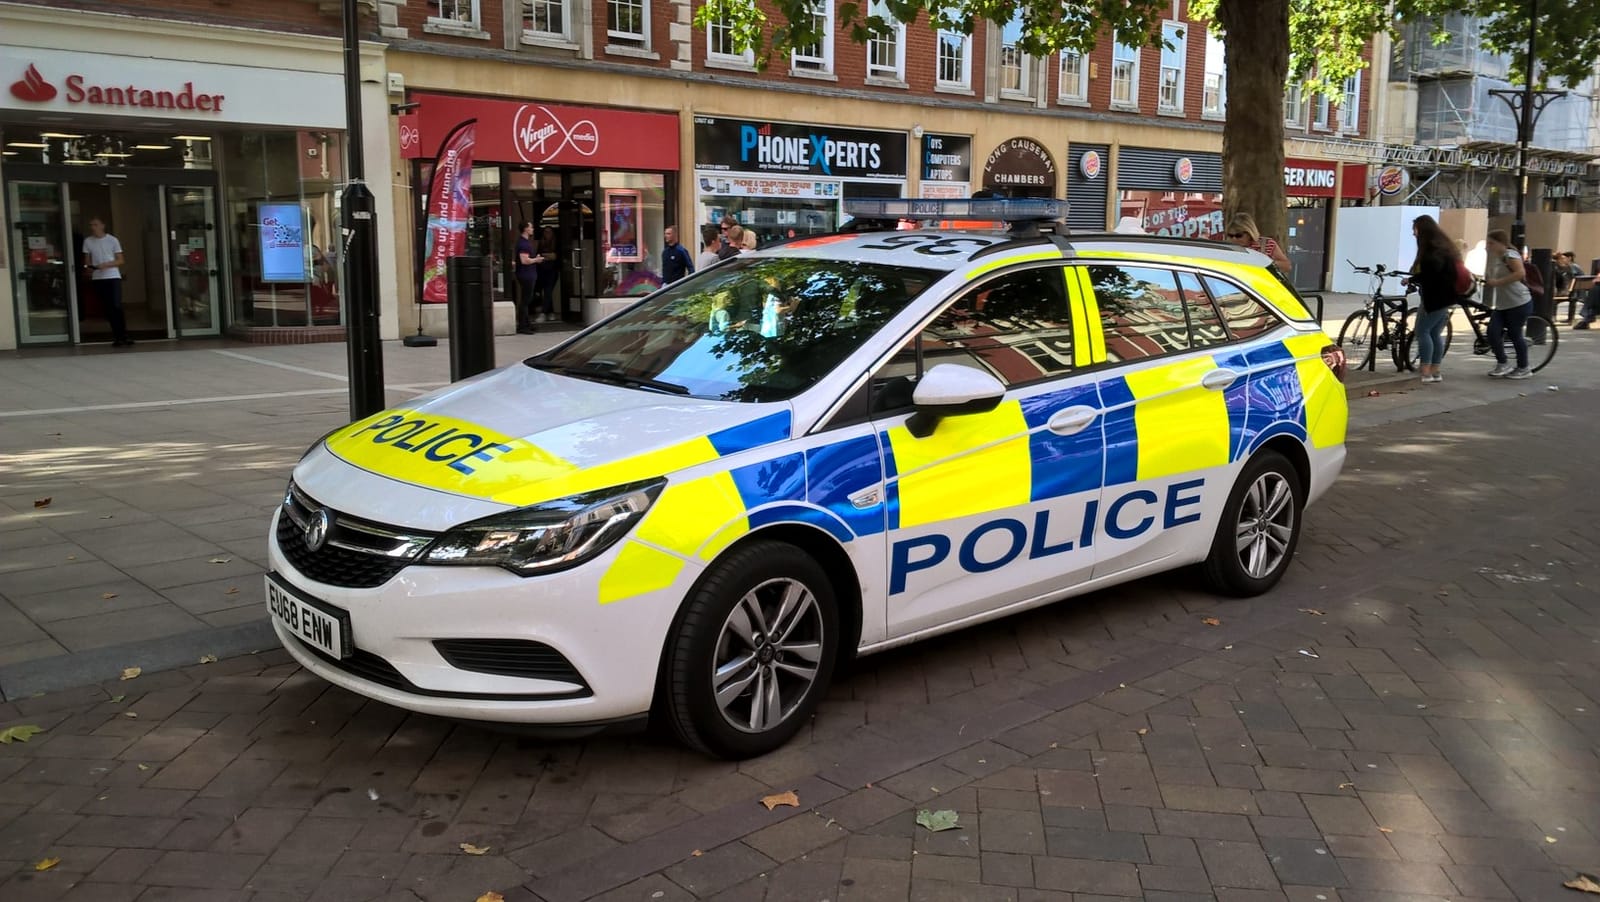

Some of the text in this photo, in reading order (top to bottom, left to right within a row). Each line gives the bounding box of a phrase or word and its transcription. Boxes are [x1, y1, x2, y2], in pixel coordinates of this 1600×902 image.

[65, 74, 225, 112] Santander
[520, 114, 558, 154] Virgin
[573, 133, 595, 142] media
[926, 136, 942, 150] TOYS
[741, 124, 881, 176] PHONEXPERTS
[926, 152, 962, 166] COMPUTERS
[984, 140, 1054, 174] LONG CAUSEWAY
[760, 180, 789, 189] COMPUTER
[926, 167, 953, 180] LAPTOPS
[994, 173, 1044, 184] CHAMBERS
[1284, 166, 1334, 188] GER KING
[263, 218, 278, 226] Get
[438, 202, 448, 224] and
[1152, 212, 1166, 226] OF
[1168, 205, 1188, 220] THE
[438, 228, 449, 242] up
[1157, 210, 1224, 240] PPER
[434, 246, 446, 276] we're
[350, 414, 514, 476] POLICE
[888, 478, 1206, 596] POLICE
[268, 584, 332, 651] EU68 ENW
